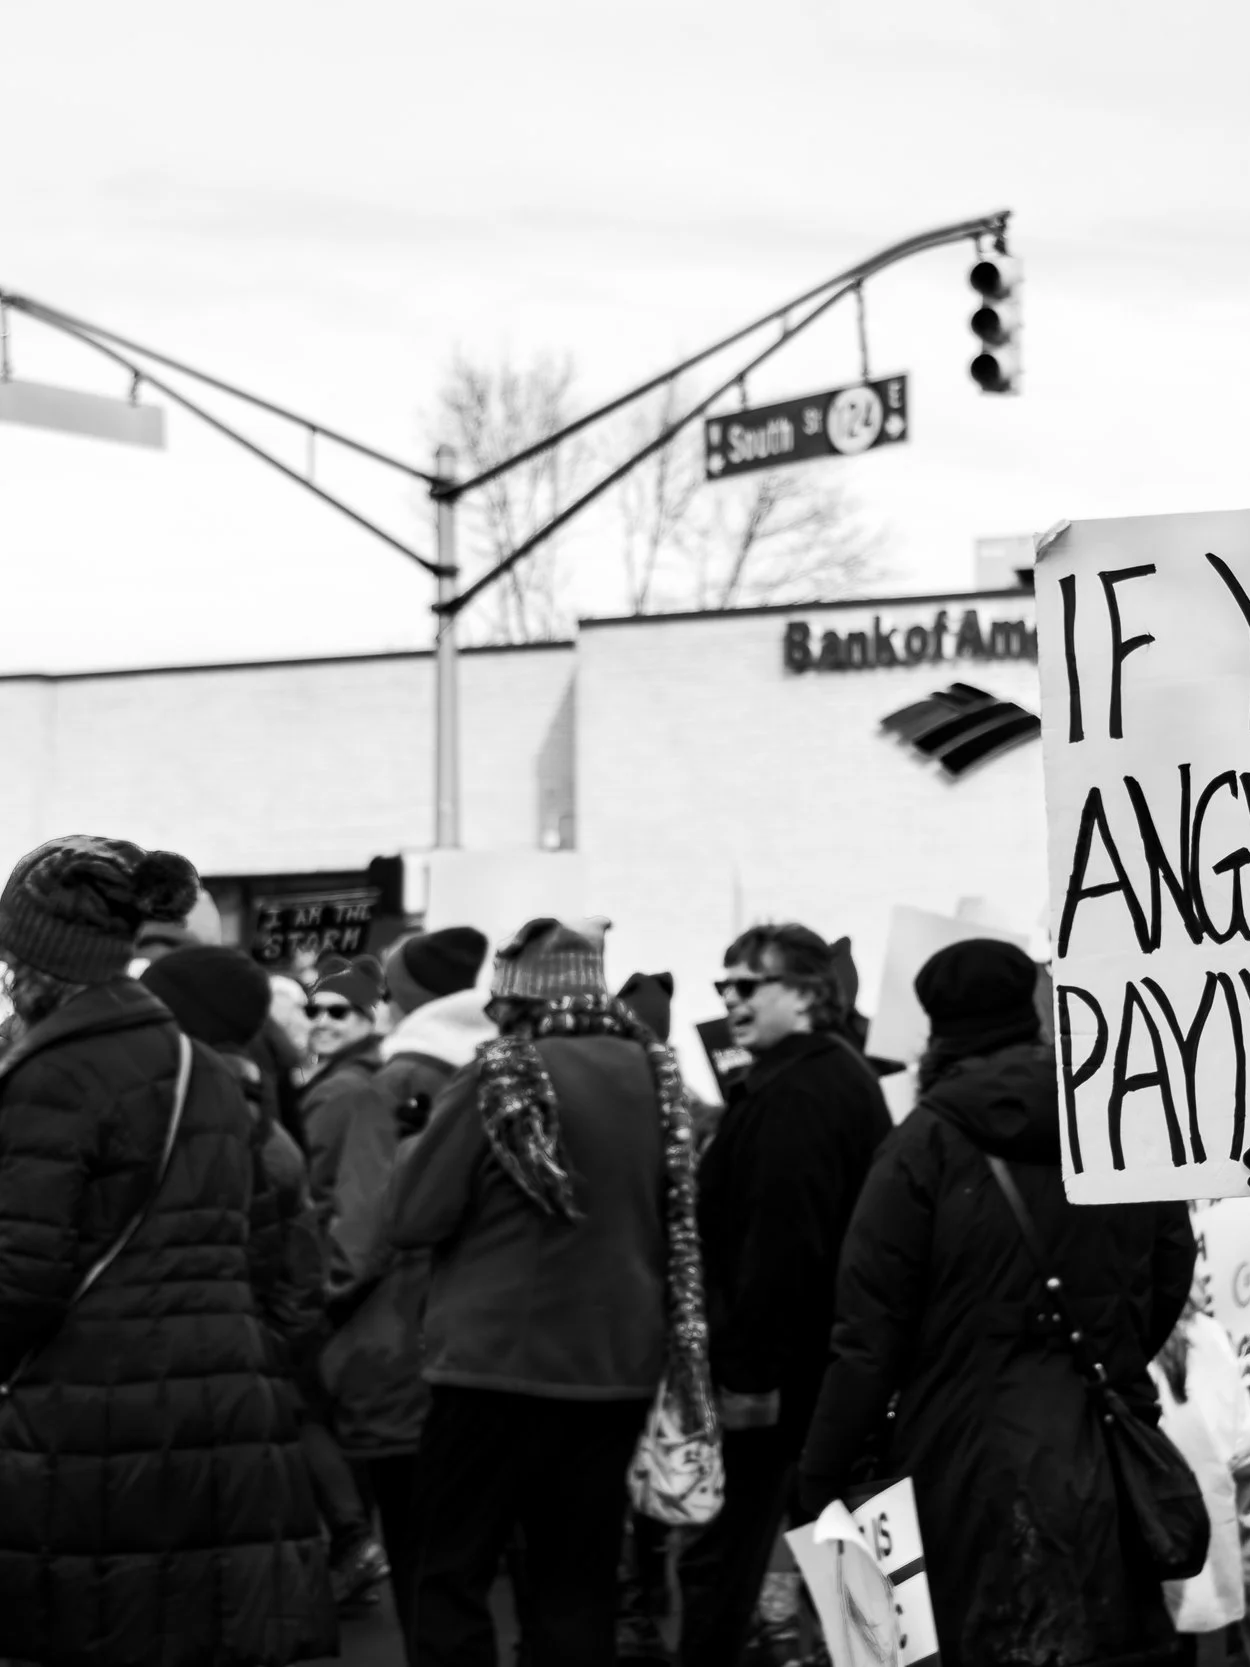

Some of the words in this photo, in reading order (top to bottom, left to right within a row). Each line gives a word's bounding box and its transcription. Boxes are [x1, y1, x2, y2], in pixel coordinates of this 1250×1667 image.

[727, 417, 795, 463] South
[785, 616, 903, 671] Bank
[904, 611, 947, 664] of
[1058, 563, 1156, 743] IF
